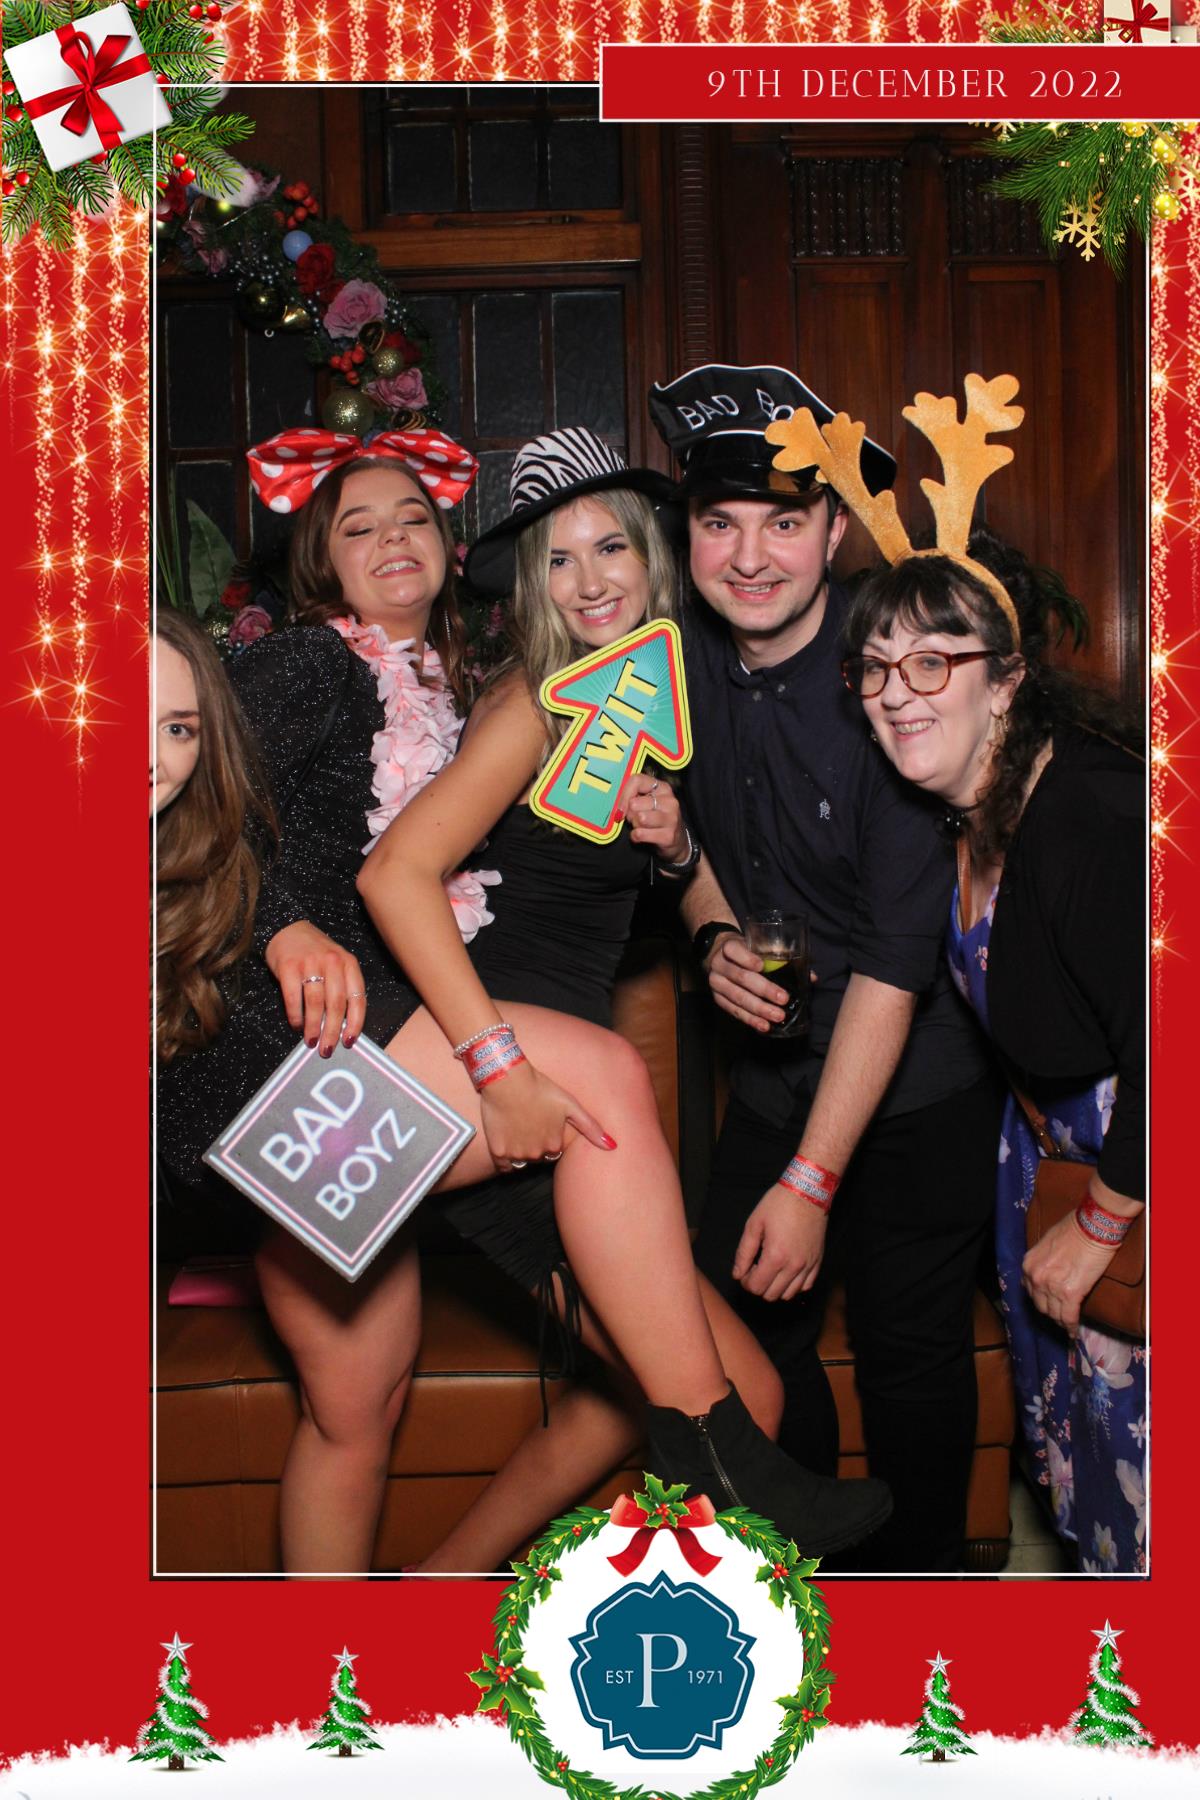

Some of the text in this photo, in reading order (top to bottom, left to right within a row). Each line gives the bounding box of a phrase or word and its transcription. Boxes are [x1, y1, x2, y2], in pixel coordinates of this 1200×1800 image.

[677, 394, 739, 430] BAD
[567, 657, 658, 794] TWIT
[259, 1069, 364, 1182] BAD
[315, 1108, 417, 1221] BOYZ
